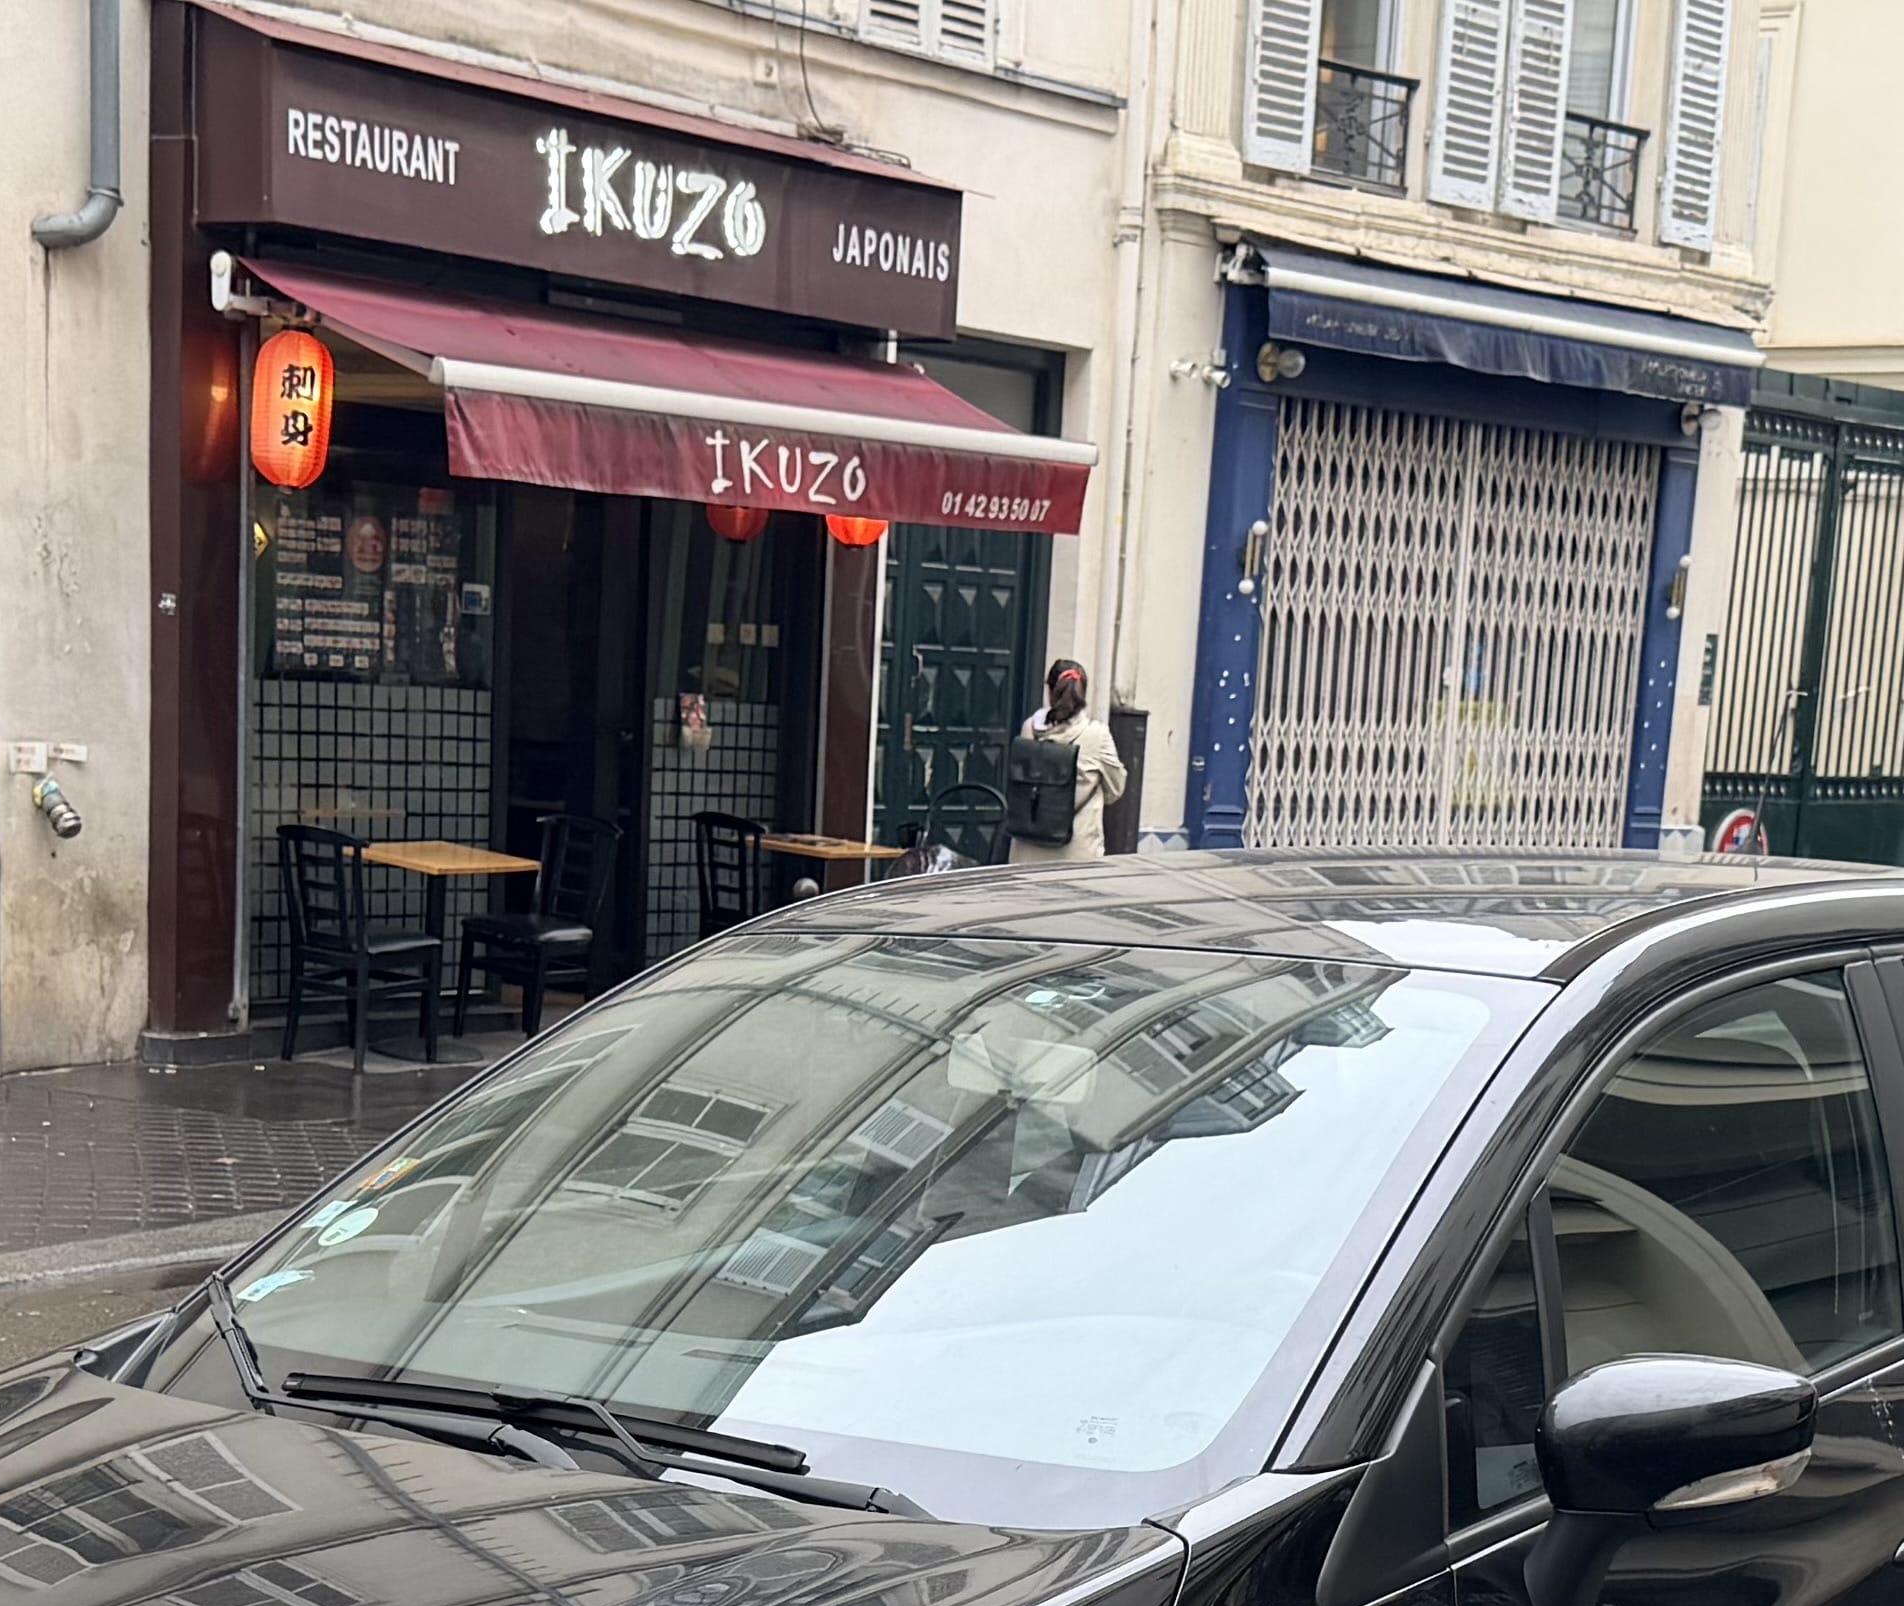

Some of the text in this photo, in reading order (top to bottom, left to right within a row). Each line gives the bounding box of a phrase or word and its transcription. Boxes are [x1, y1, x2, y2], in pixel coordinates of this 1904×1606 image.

[288, 108, 460, 185] RESTAURANT
[534, 127, 767, 261] IKUZO
[832, 223, 950, 282] JAPONAIS
[280, 363, 316, 446] 刺身
[705, 428, 867, 505] IKUZO
[941, 491, 1051, 522] 01 42 93 50 07
